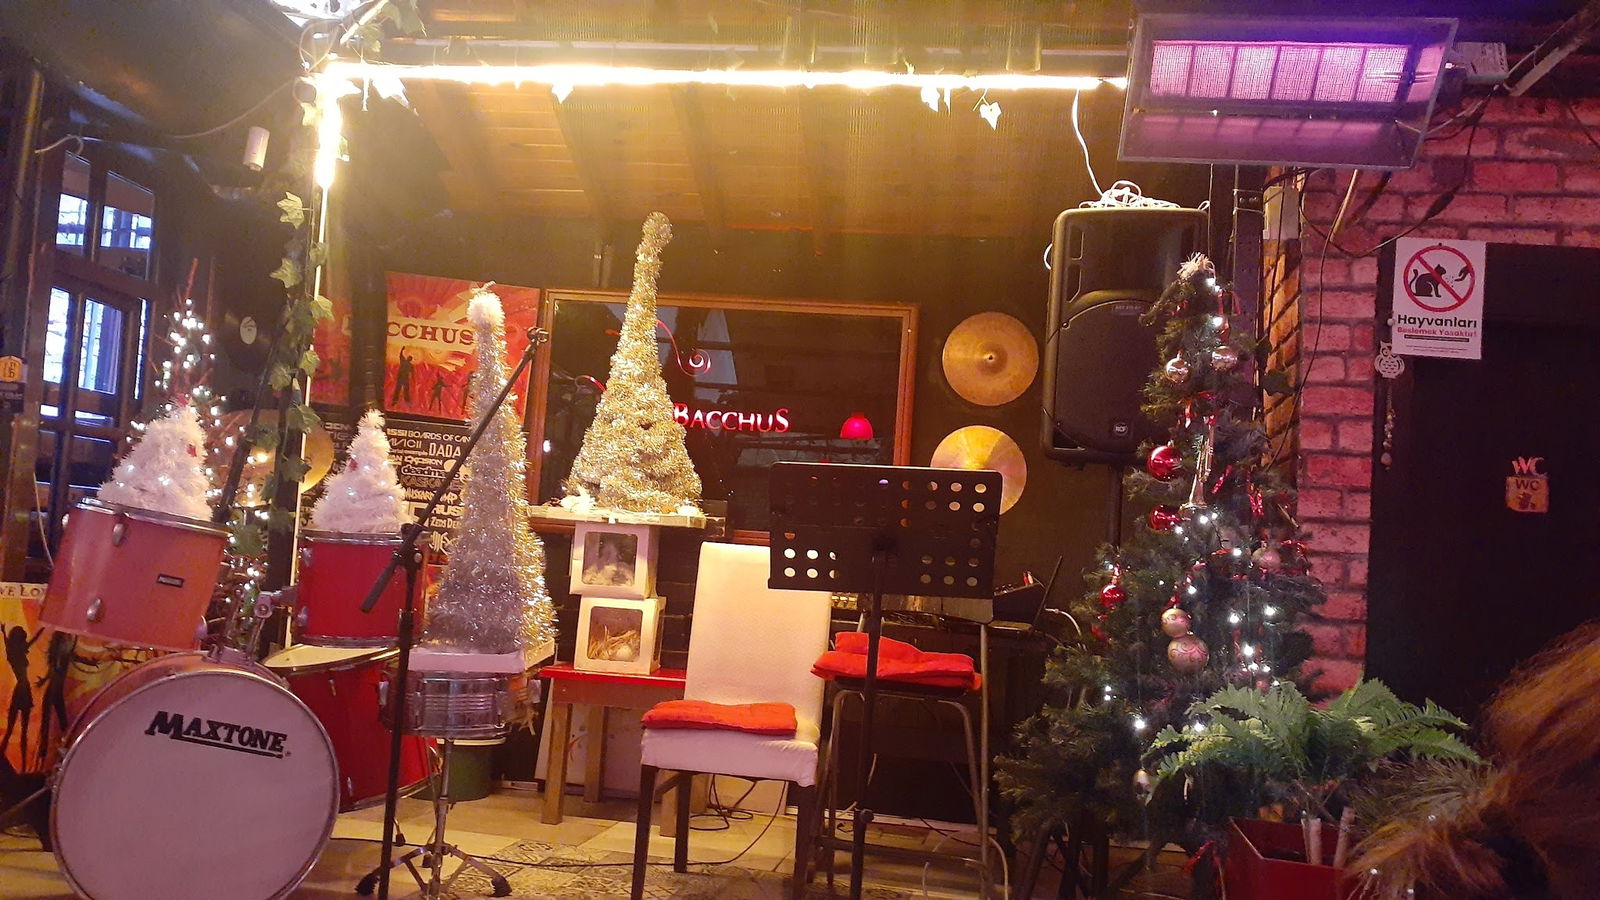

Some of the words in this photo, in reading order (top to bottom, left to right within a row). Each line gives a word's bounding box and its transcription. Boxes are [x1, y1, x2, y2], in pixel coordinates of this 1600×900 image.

[1397, 314, 1477, 329] Hayvanları
[674, 402, 789, 433] BACCHUS
[408, 431, 442, 440] BOARDS
[443, 433, 454, 441] OF
[429, 443, 461, 458] DADA
[1512, 456, 1547, 477] WC
[145, 711, 287, 752] MAXTONE
